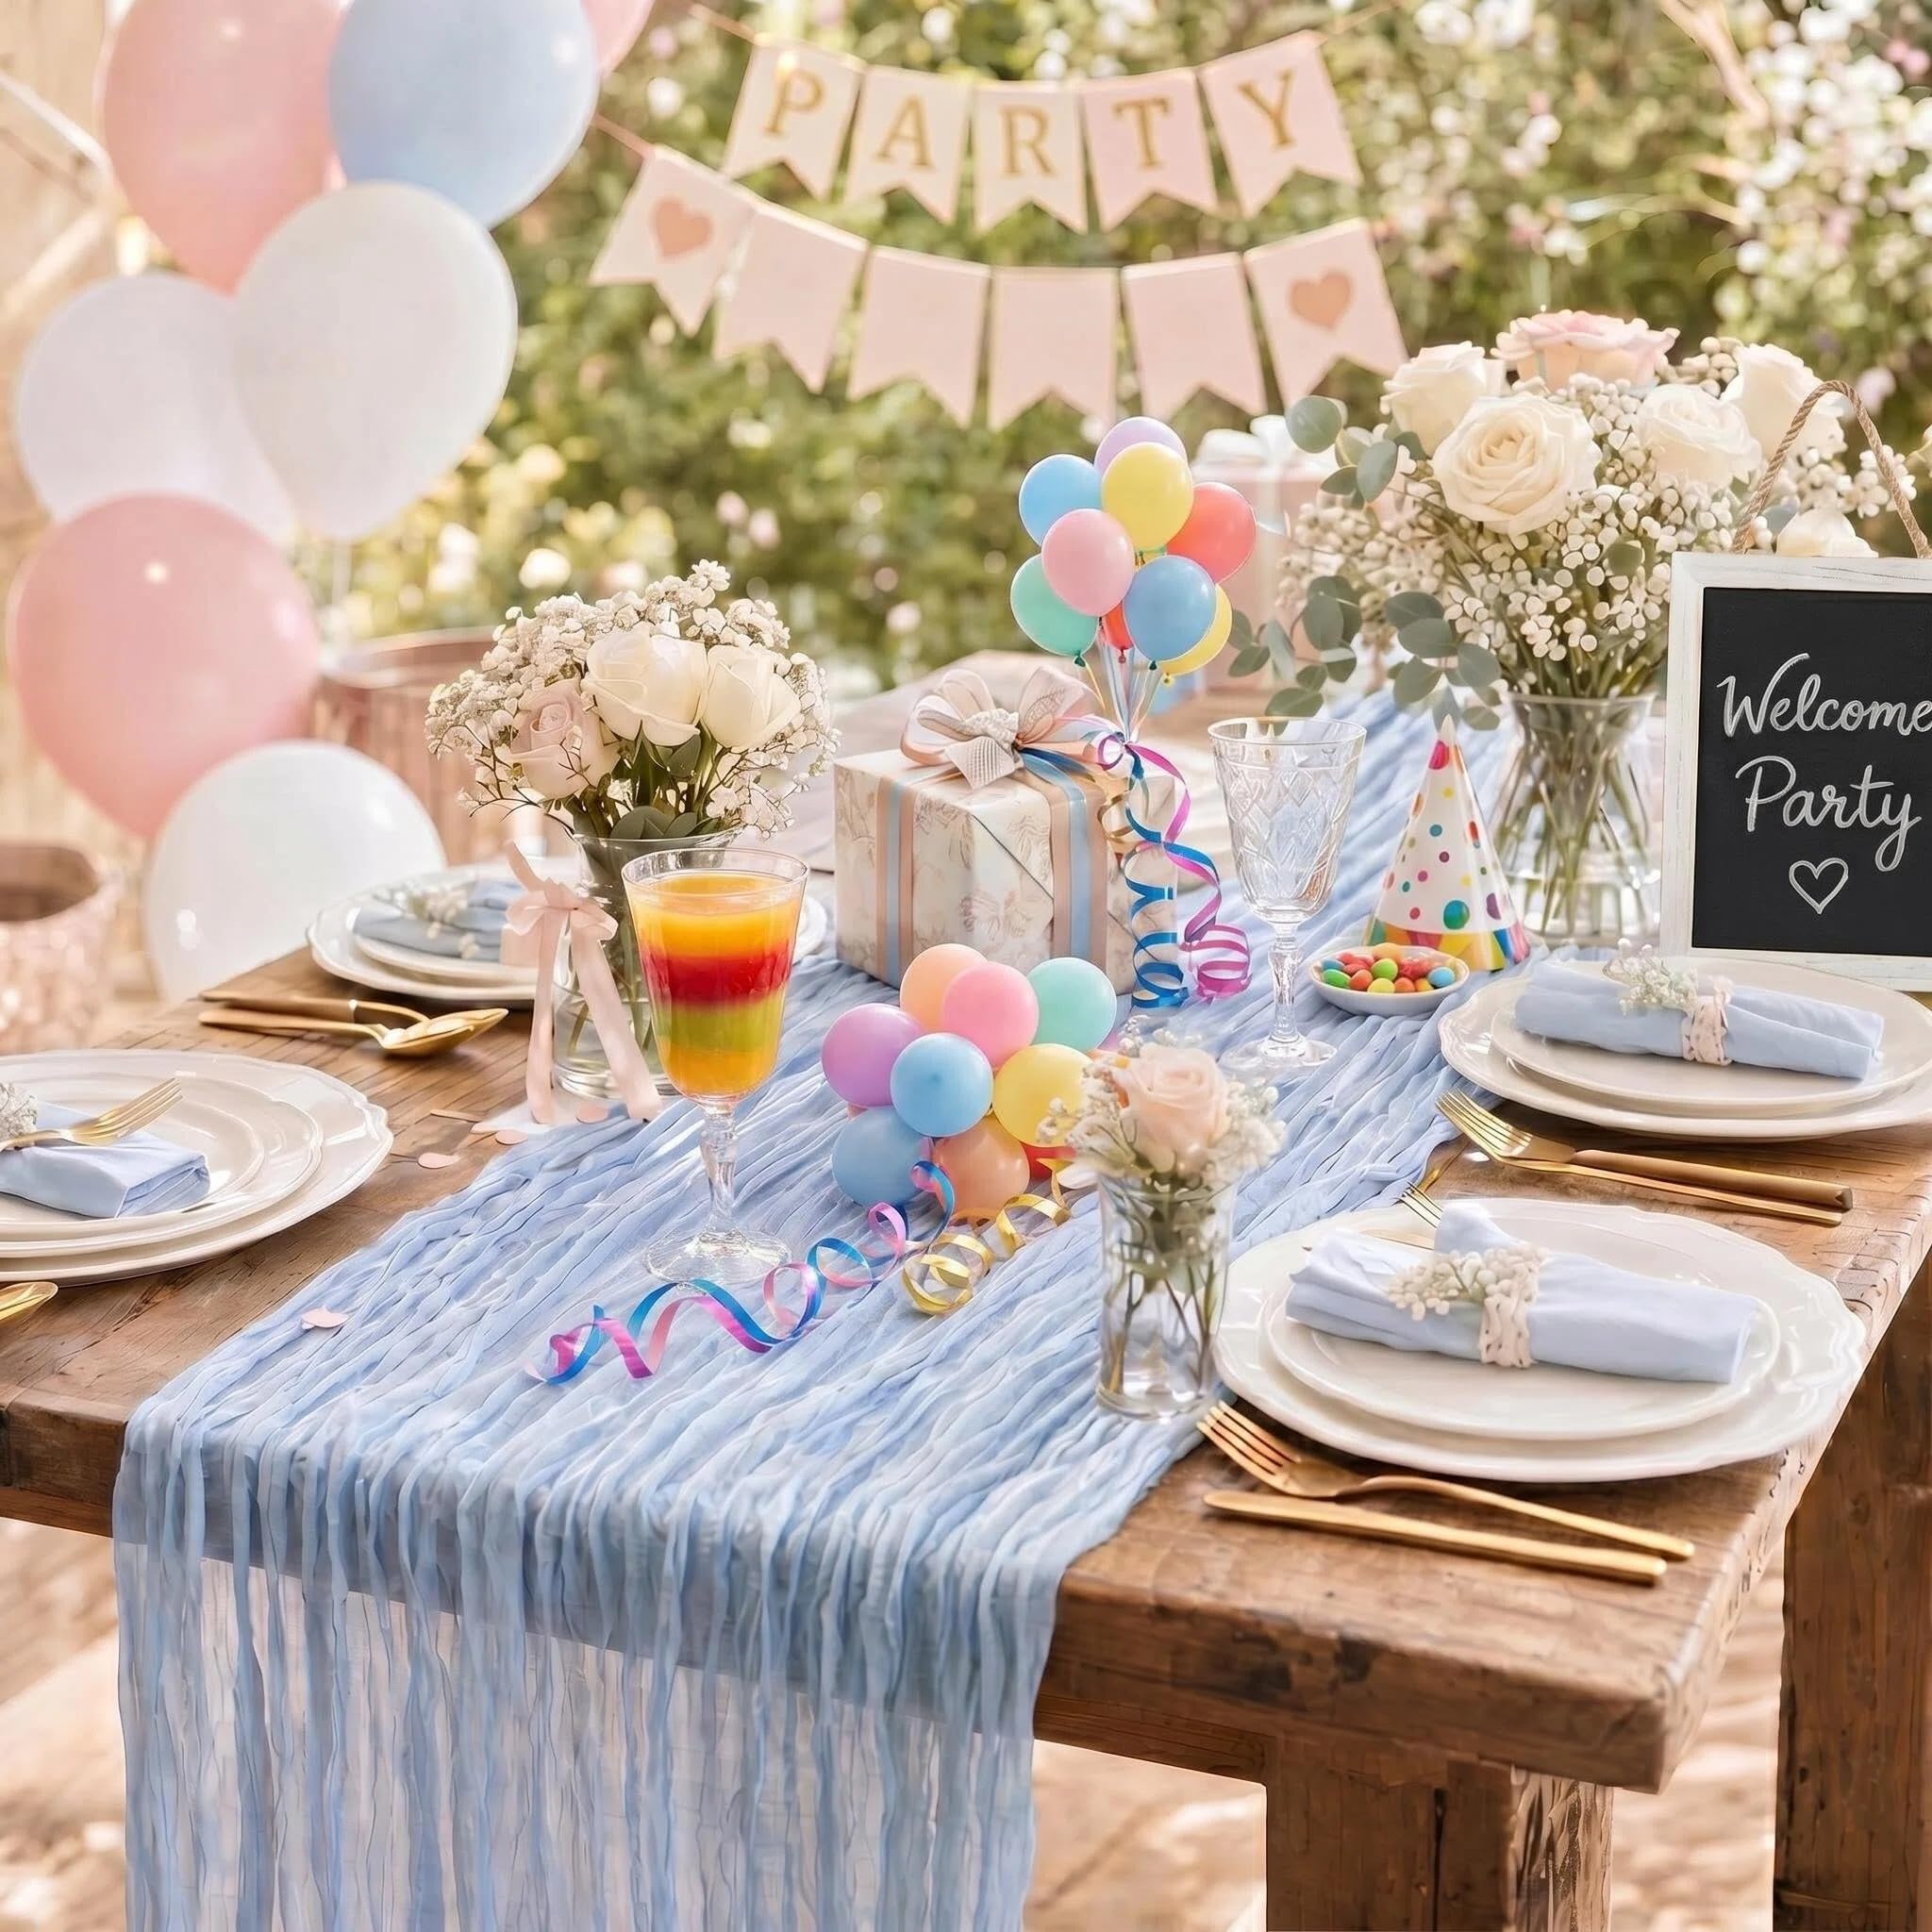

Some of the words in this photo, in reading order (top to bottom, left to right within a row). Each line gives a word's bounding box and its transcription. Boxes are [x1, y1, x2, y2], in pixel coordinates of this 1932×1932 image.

[763, 68, 1297, 176] PARTY
[1716, 652, 1932, 738] Welcome
[1735, 755, 1923, 873] Party
